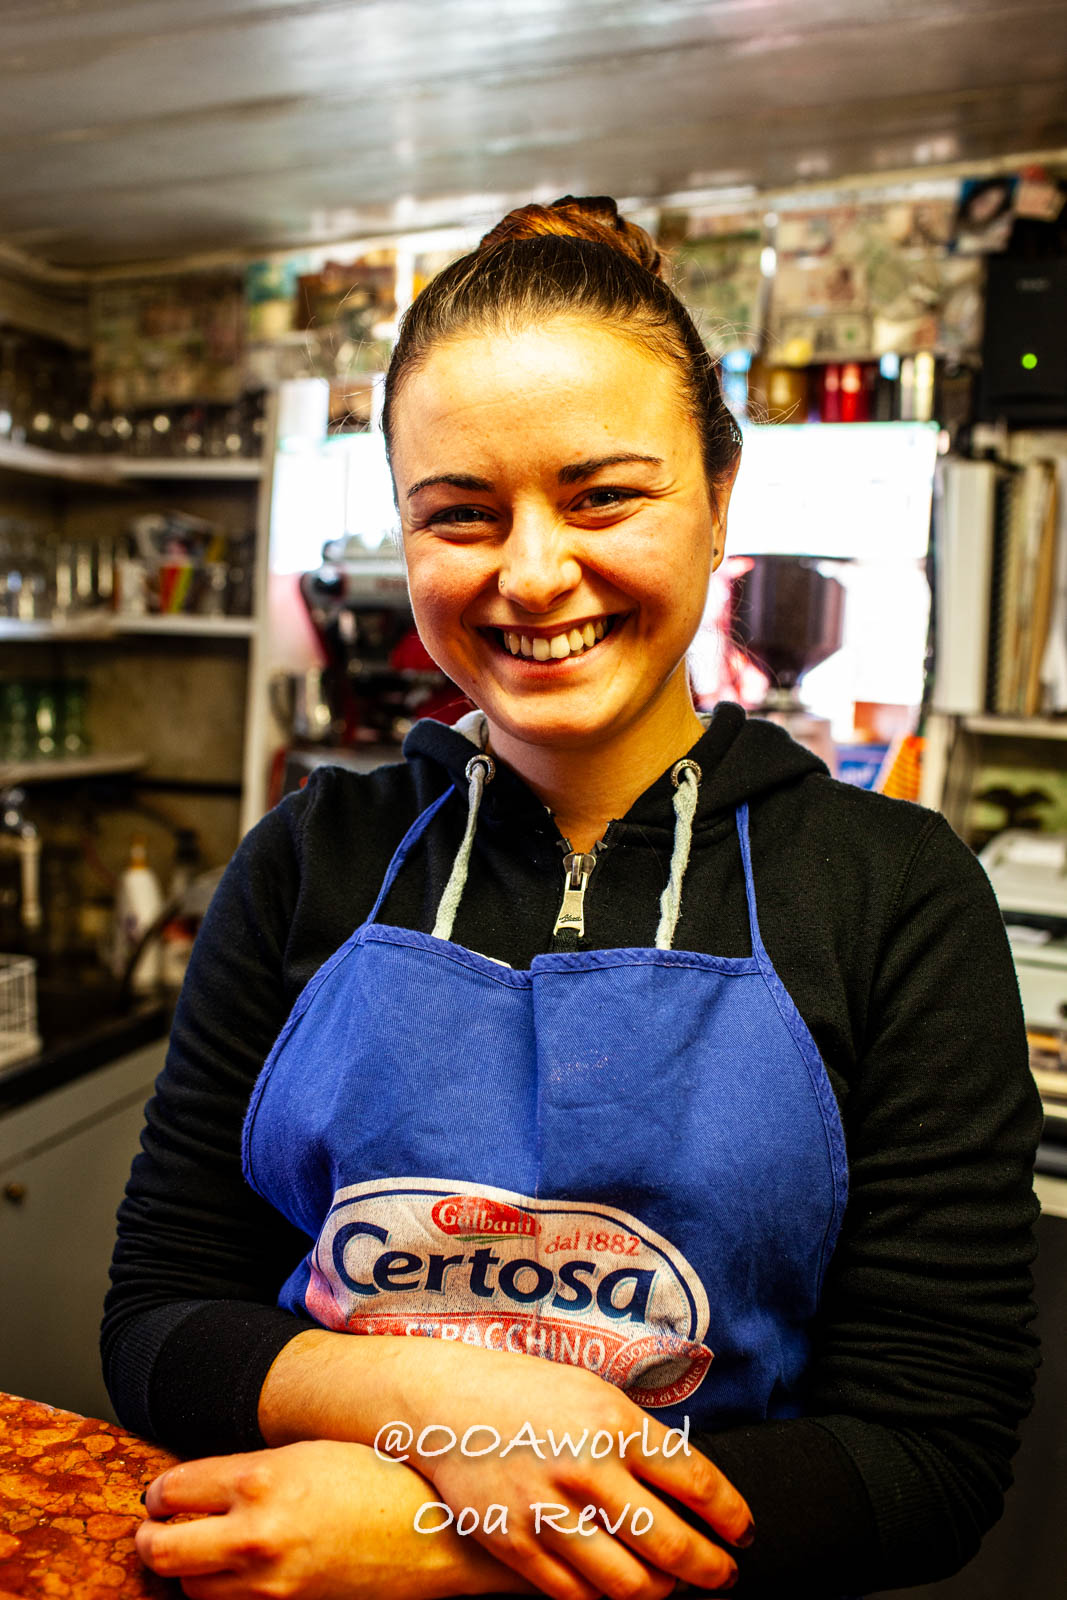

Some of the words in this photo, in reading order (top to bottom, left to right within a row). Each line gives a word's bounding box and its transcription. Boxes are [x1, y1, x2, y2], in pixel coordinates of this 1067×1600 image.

[438, 1203, 532, 1233] Galbani
[544, 1229, 580, 1254] dal
[584, 1230, 640, 1256] 1882
[331, 1221, 658, 1323] Certosa
